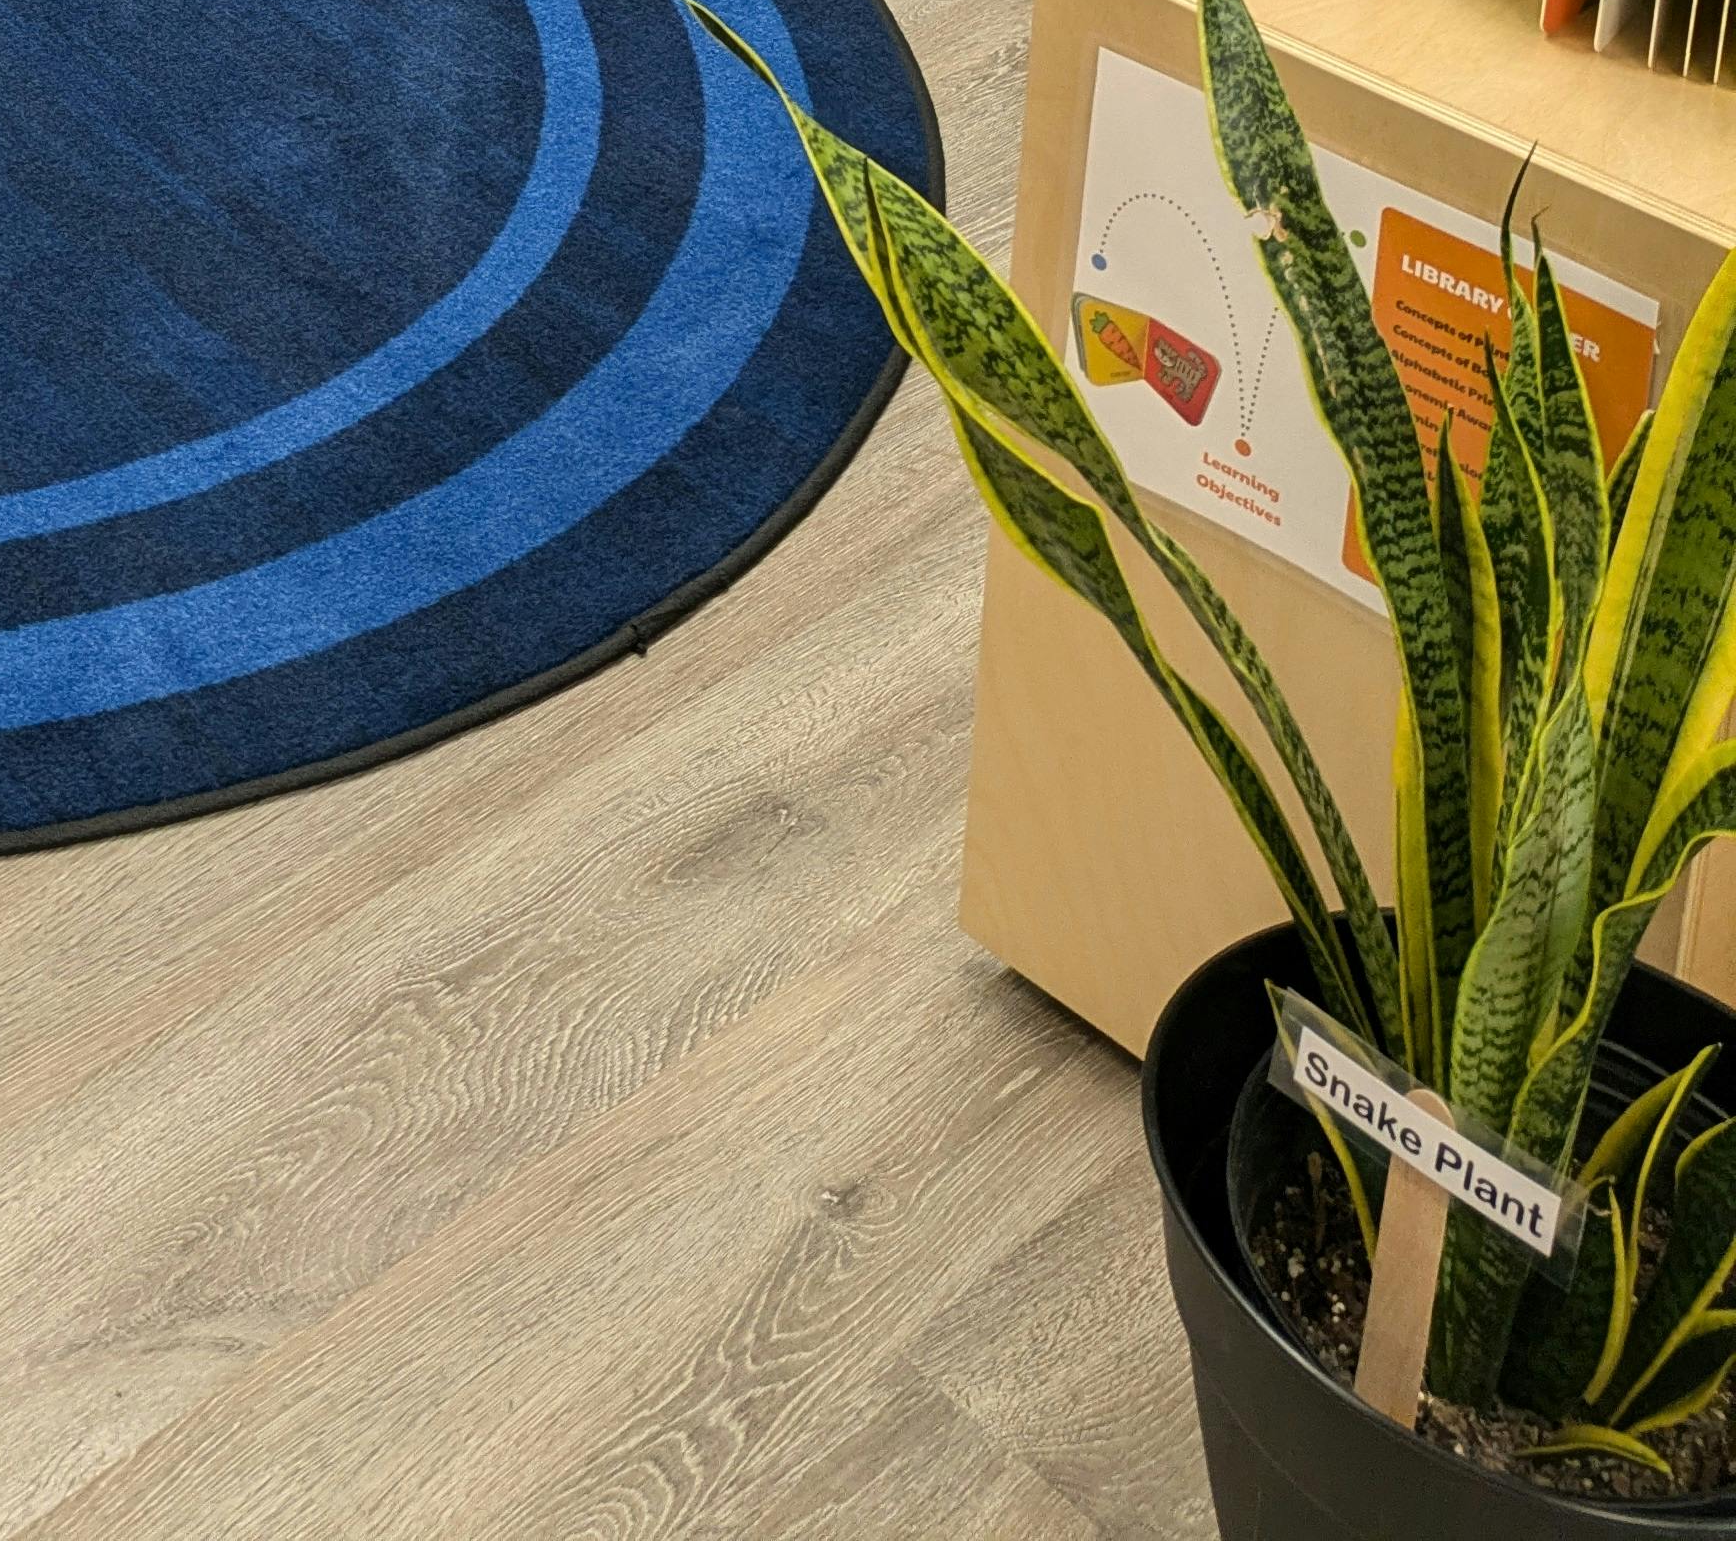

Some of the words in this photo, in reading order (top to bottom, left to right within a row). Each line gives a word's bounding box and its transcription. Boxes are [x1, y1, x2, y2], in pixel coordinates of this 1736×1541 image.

[1401, 254, 1505, 315] LIBRARY
[1392, 324, 1454, 361] Concepts
[1454, 354, 1470, 369] of
[1395, 300, 1457, 336] Concepts
[1457, 330, 1474, 345] of
[1474, 335, 1510, 362] Pint
[1391, 348, 1467, 395] Alphabetic
[1195, 473, 1283, 527] Objectives
[1202, 451, 1281, 504] Learning
[1303, 1051, 1425, 1159] Snake
[1434, 1137, 1546, 1242] Plant
